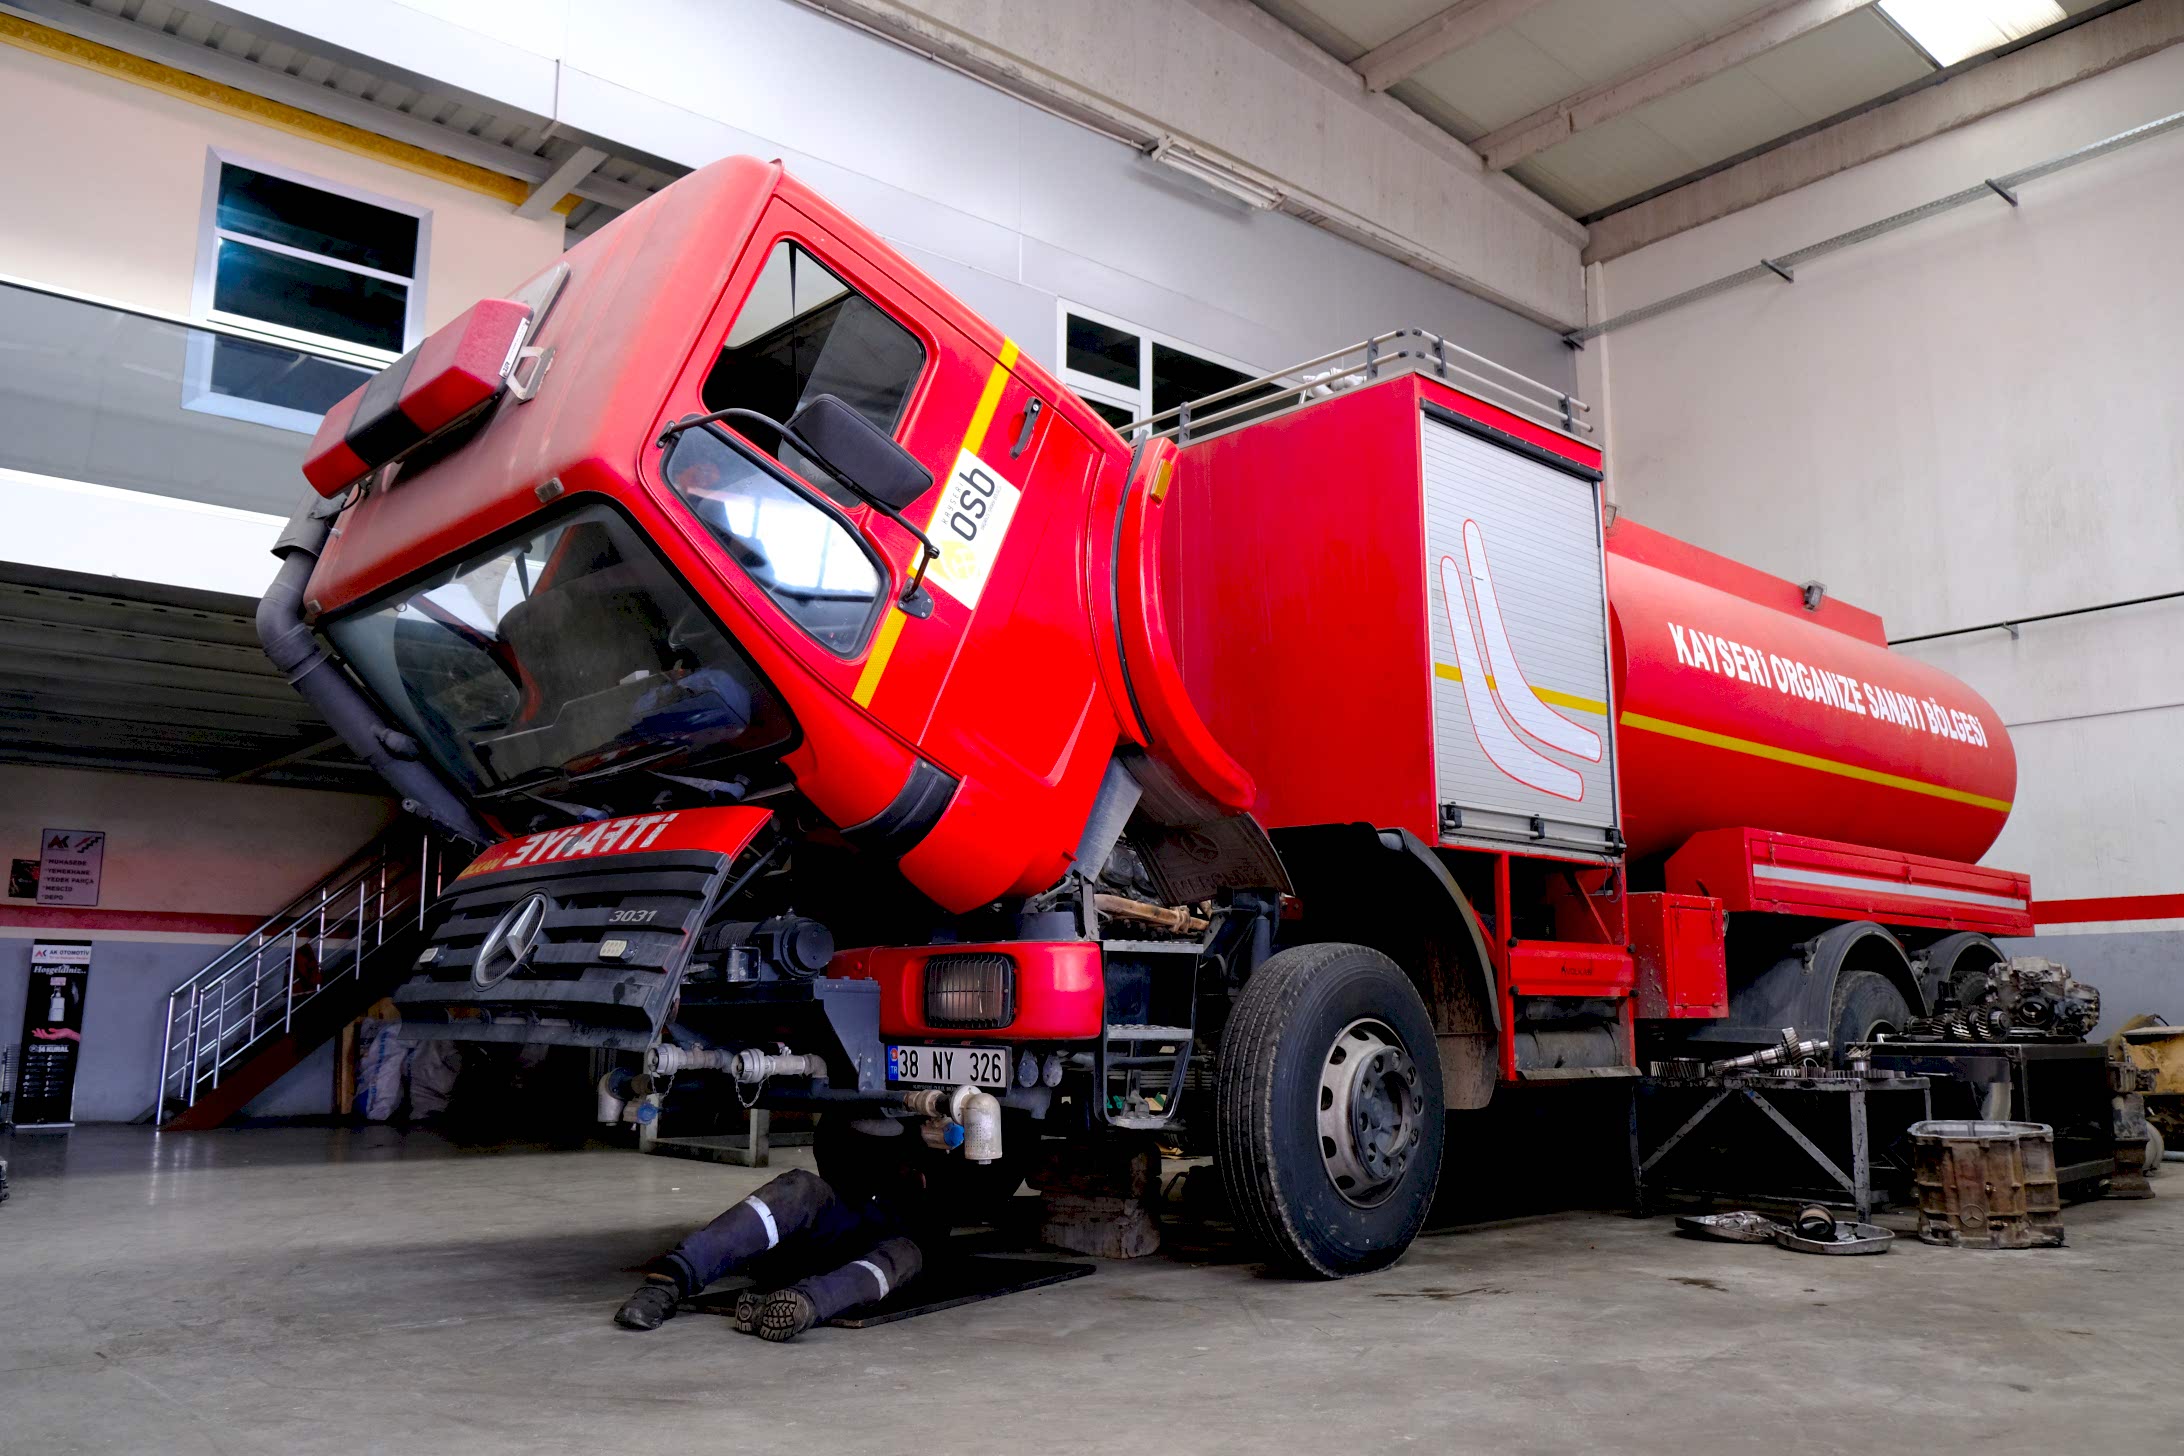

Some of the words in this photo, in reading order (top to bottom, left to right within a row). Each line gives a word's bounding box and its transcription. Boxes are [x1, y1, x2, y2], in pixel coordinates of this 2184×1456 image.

[950, 468, 995, 541] osb
[1667, 621, 1772, 688] KAYSERİ
[1769, 653, 1866, 715] ORGANİZE
[1863, 682, 1926, 731] SANAYİ
[1920, 697, 1988, 748] BÖLGESİ
[609, 910, 658, 922] 3031
[890, 1065, 898, 1074] TR
[899, 1049, 919, 1078] 38
[932, 1050, 954, 1080] NY
[969, 1052, 1002, 1083] 326
